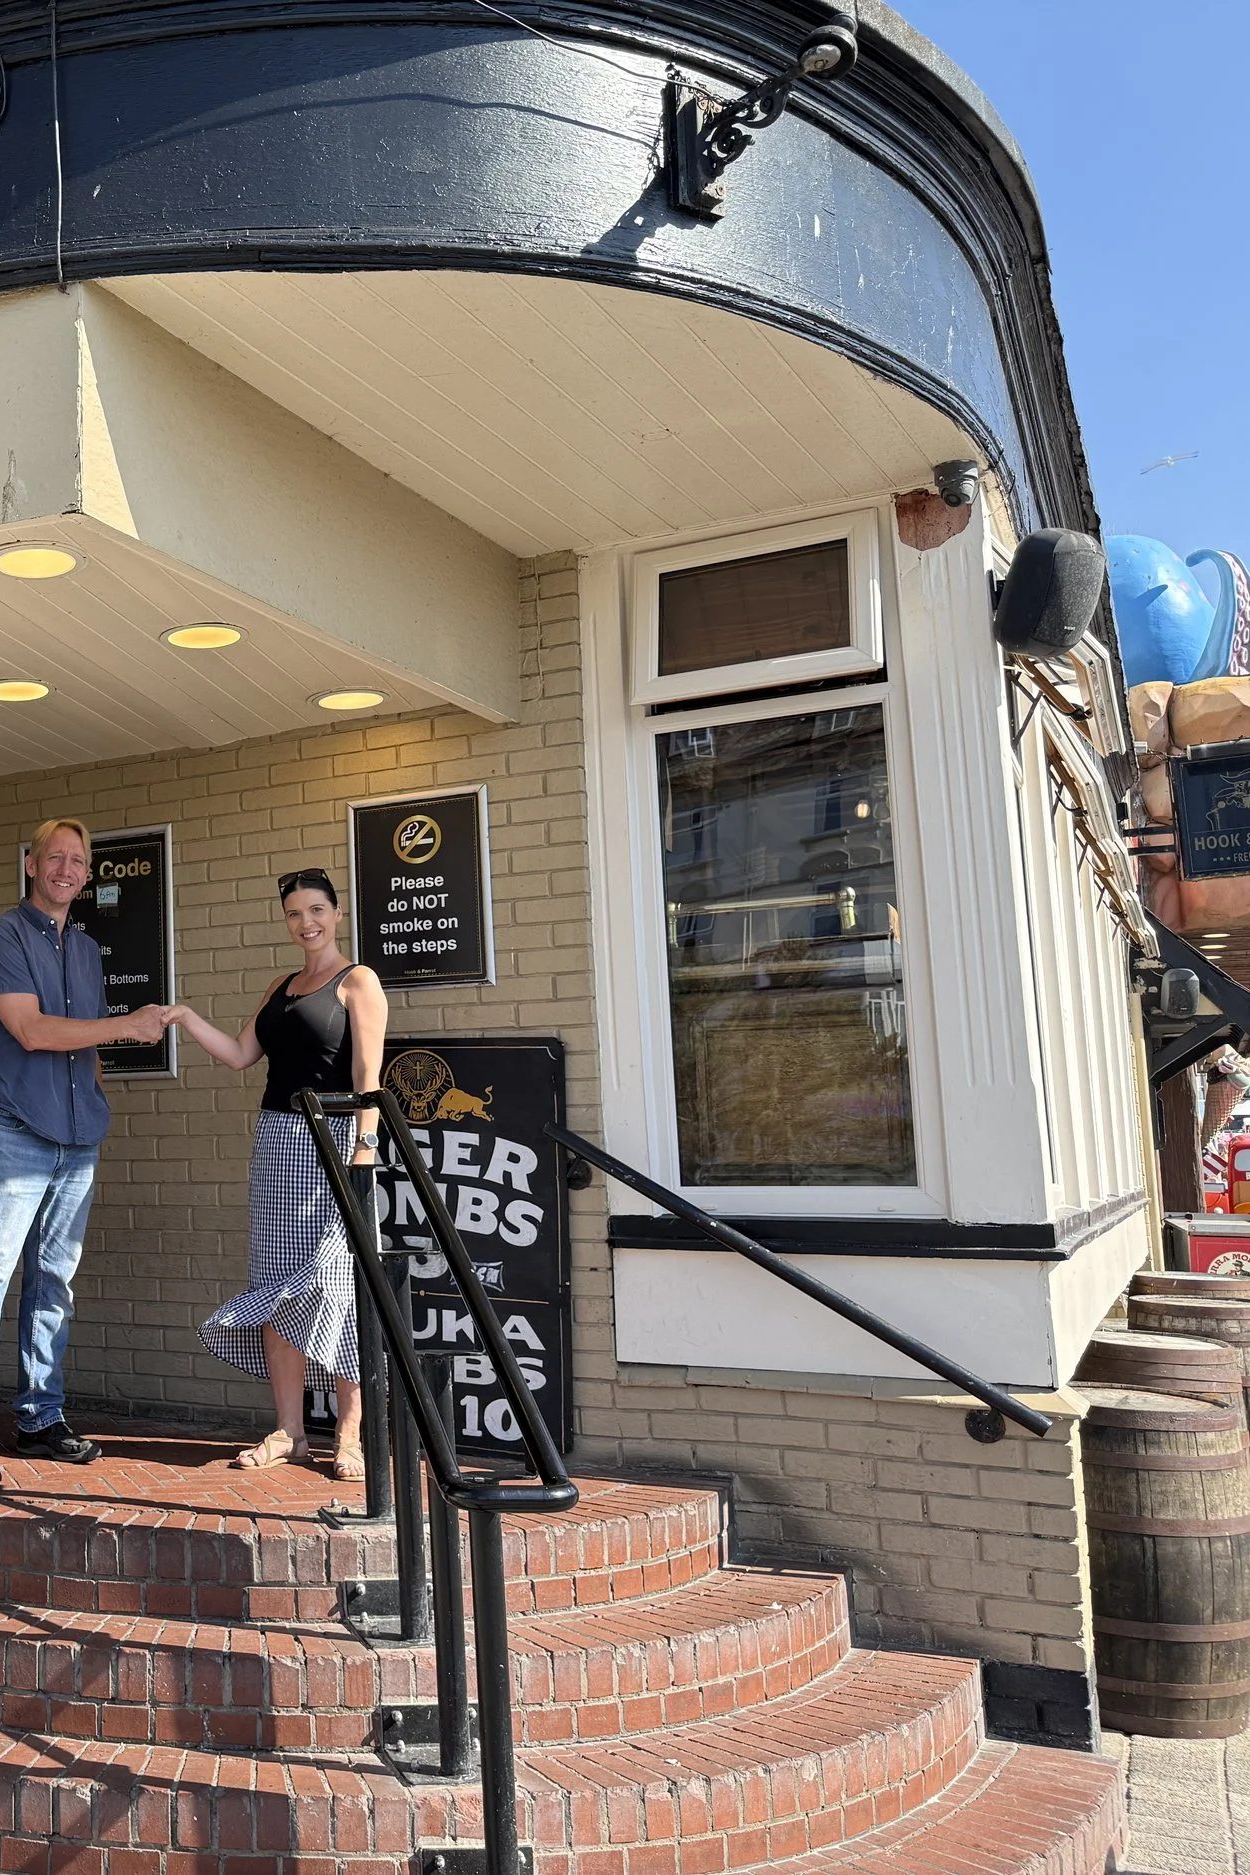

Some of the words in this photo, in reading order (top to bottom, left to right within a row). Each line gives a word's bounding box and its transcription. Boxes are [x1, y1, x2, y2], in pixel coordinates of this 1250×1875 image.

[1194, 833, 1241, 851] HOOK
[99, 858, 152, 878] Code
[391, 875, 444, 891] Please
[387, 898, 408, 912] do
[412, 893, 449, 910] NOT
[379, 917, 433, 935] smoke
[437, 916, 459, 930] on
[382, 941, 408, 955] the
[412, 938, 458, 955] steps
[110, 974, 149, 985] Bottoms
[1232, 1253, 1250, 1263] MO
[460, 1395, 524, 1441] 10
